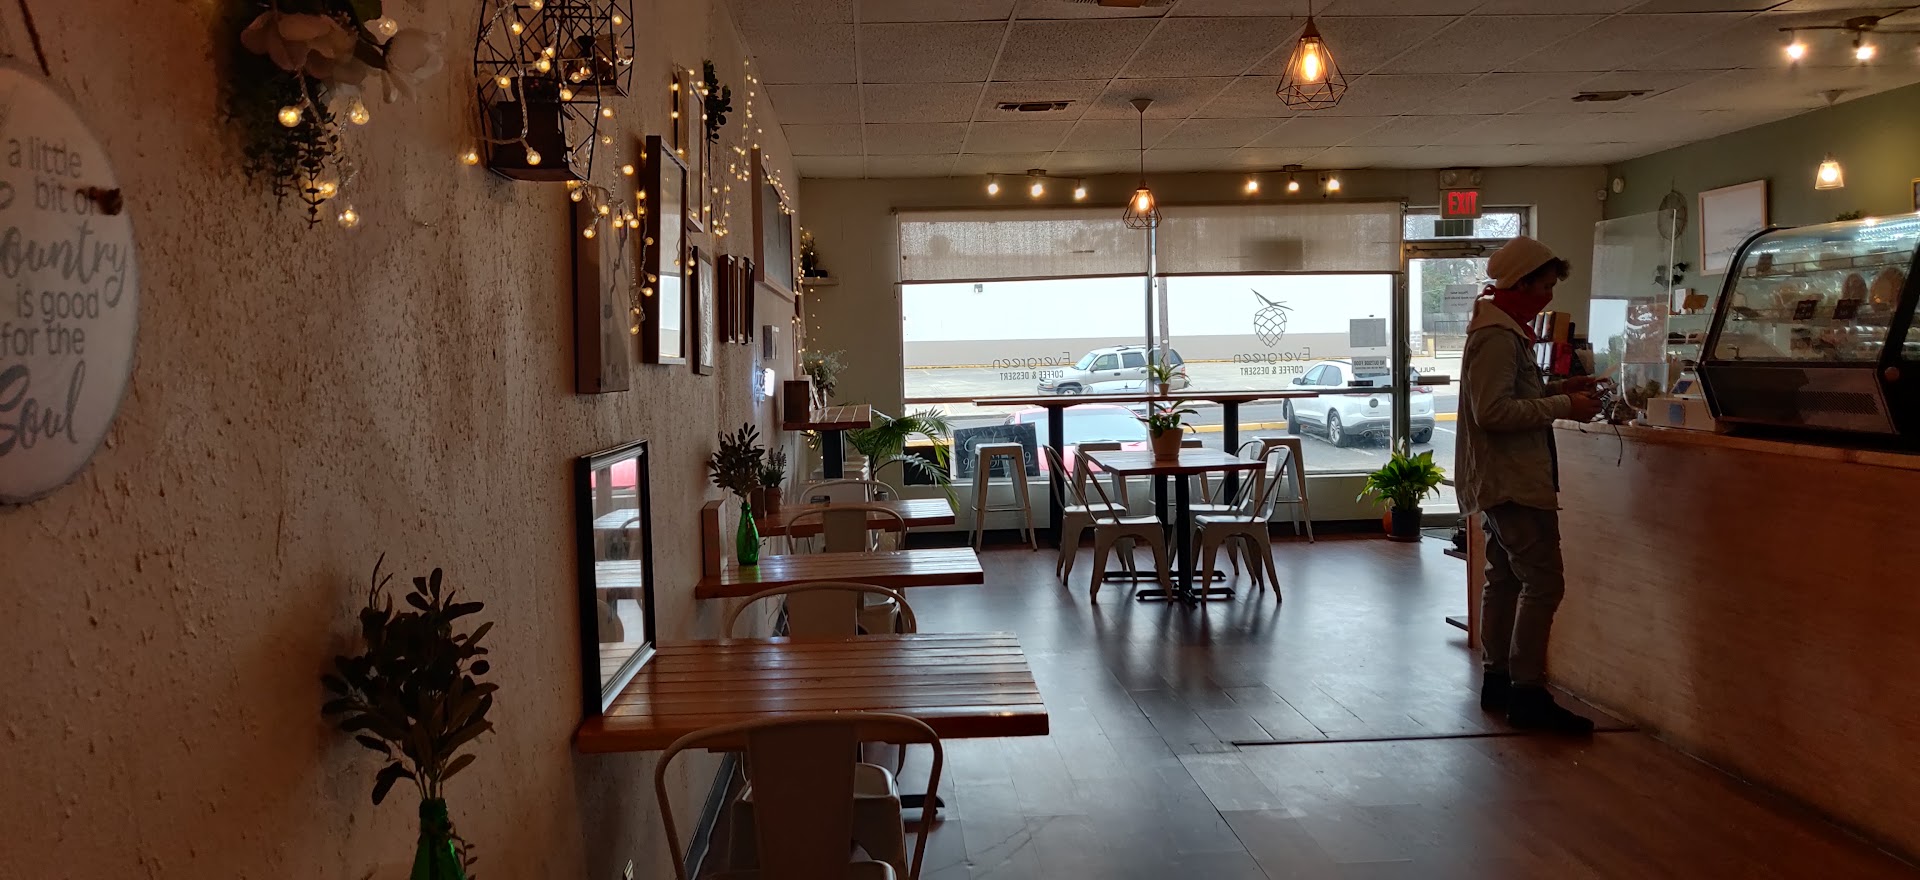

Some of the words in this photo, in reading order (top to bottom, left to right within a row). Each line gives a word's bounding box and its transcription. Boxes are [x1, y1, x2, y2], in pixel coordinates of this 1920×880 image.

[8, 138, 21, 168] a
[28, 136, 82, 178] little
[35, 176, 68, 213] bit
[1448, 191, 1478, 215] EXIT
[0, 219, 127, 308] ountry
[16, 283, 34, 318] is
[41, 288, 99, 324] good
[1, 321, 39, 356] for
[47, 321, 85, 355] the
